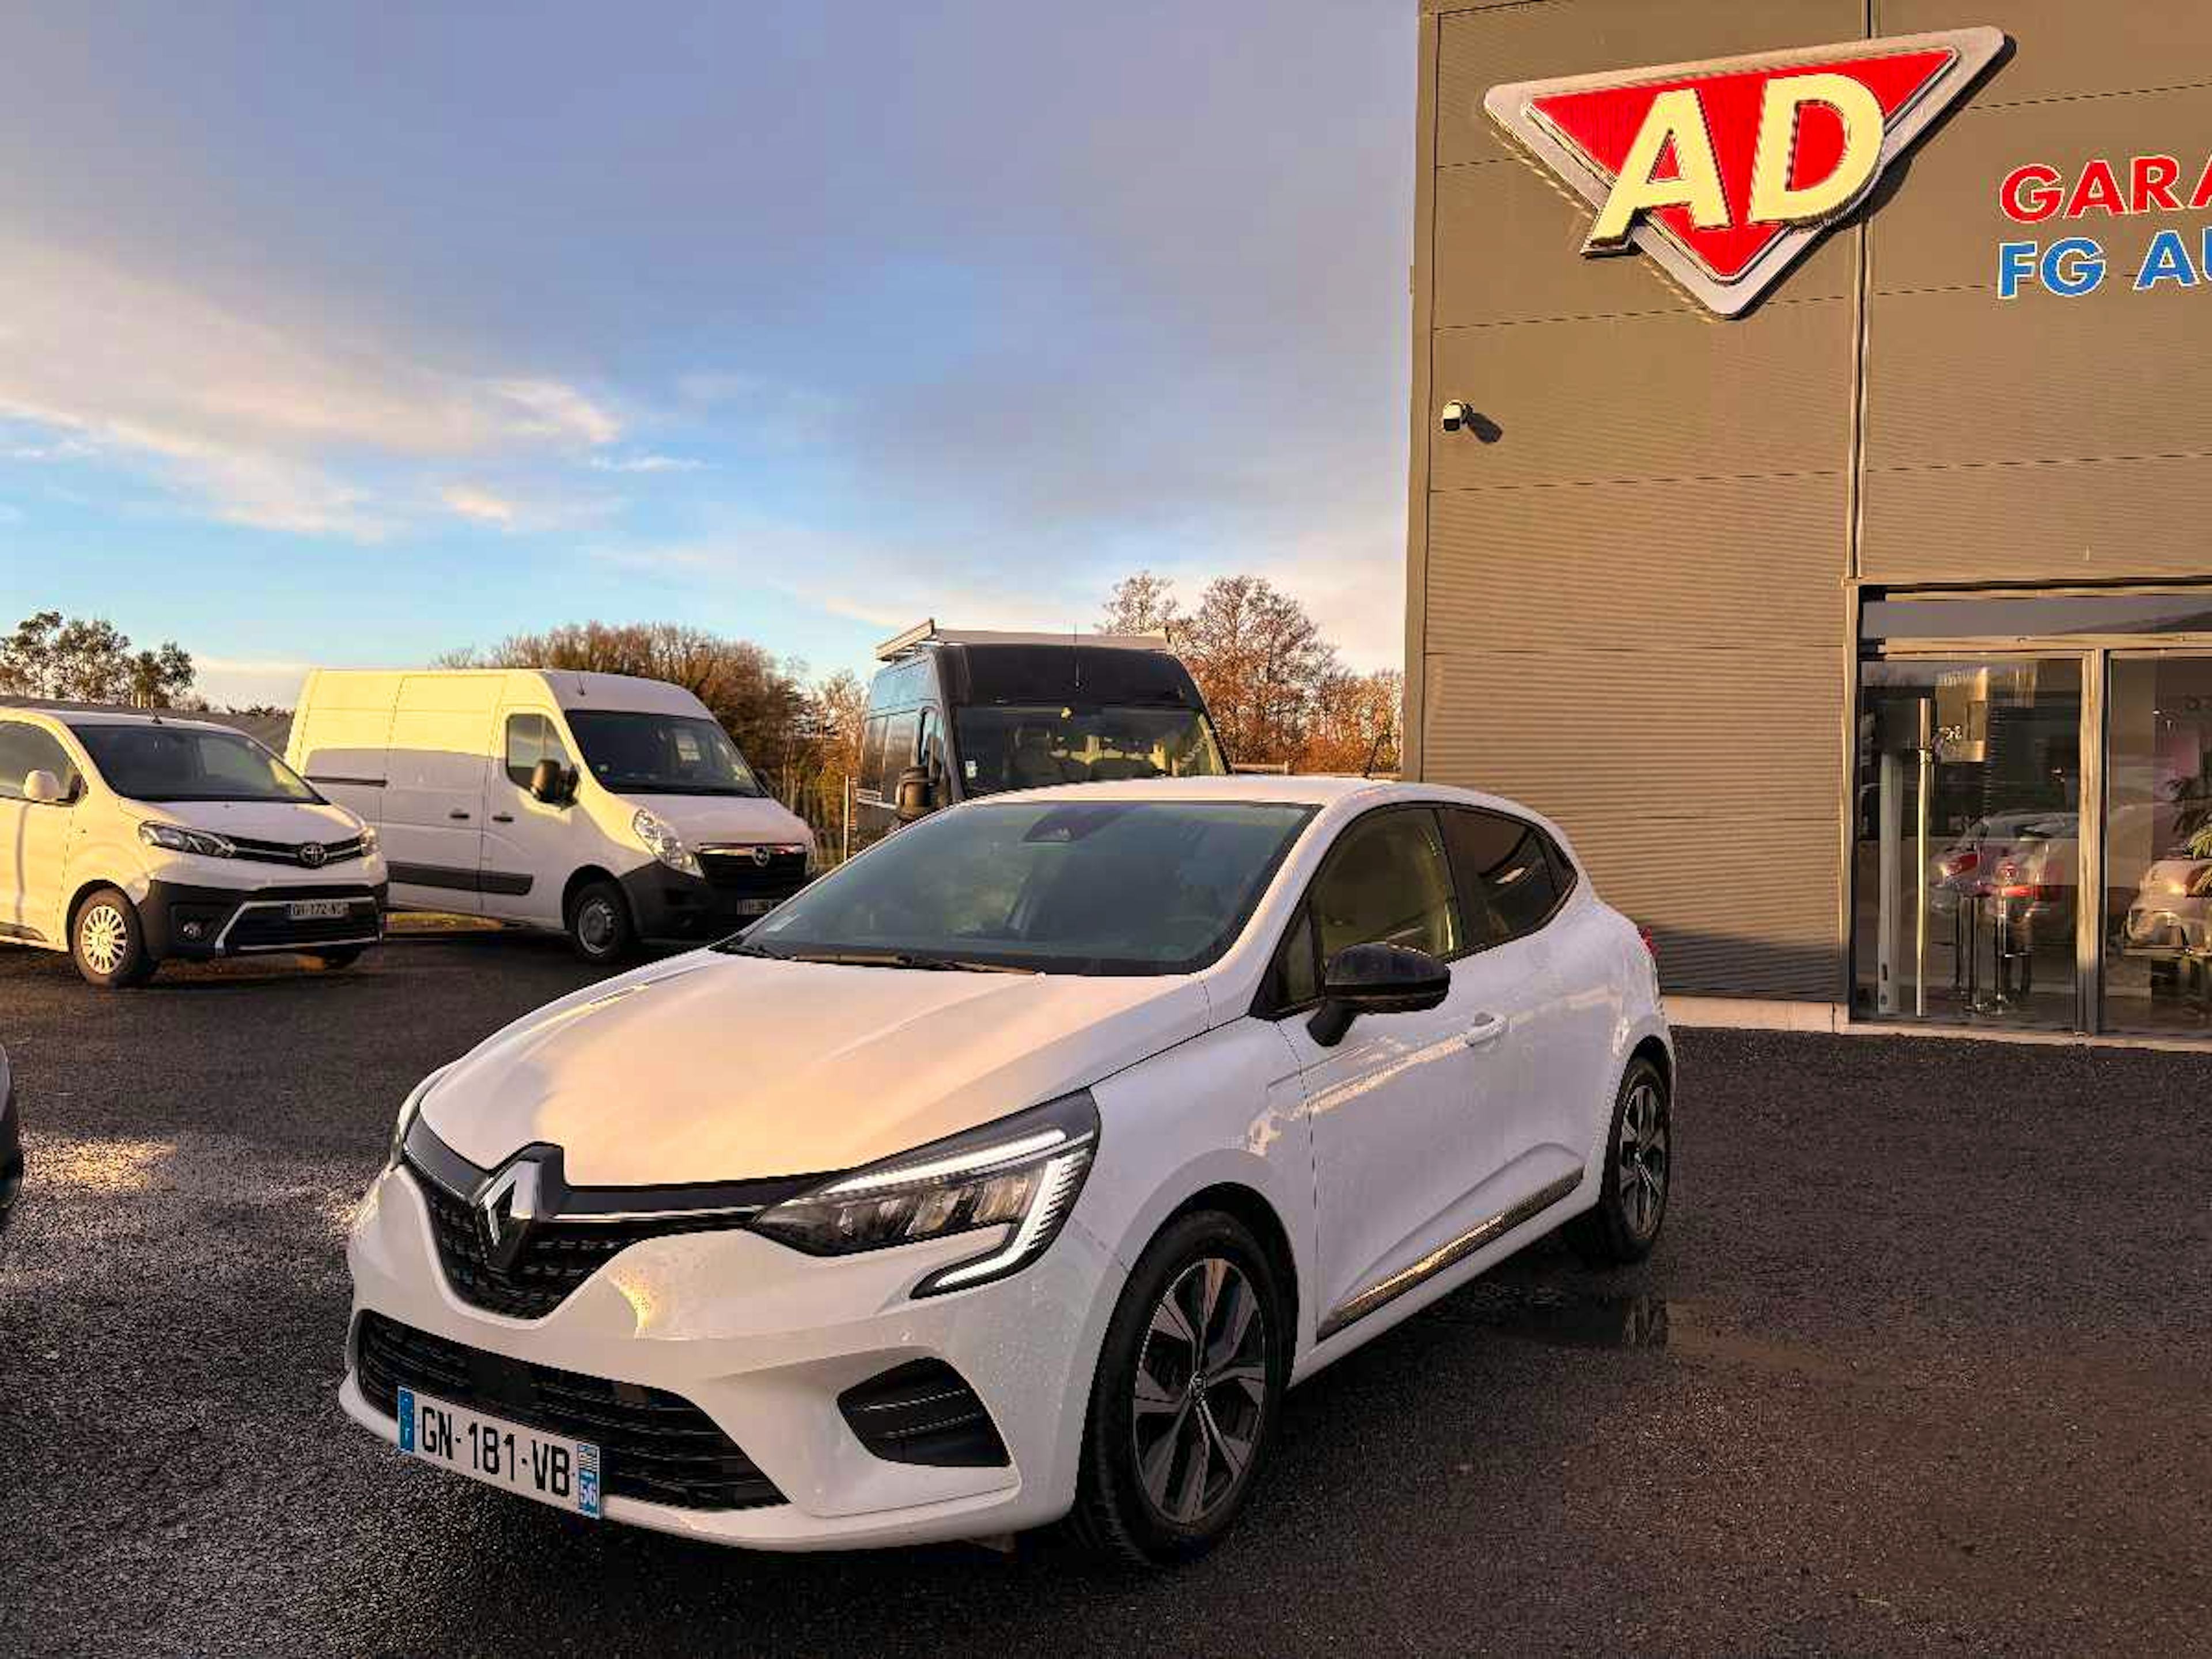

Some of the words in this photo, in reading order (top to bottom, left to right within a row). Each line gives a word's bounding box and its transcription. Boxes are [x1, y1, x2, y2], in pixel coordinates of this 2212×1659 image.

[1585, 71, 1887, 253] AD
[1997, 237, 2106, 299] FG
[2132, 226, 2212, 290] A
[422, 1406, 570, 1497] GN-181-VB
